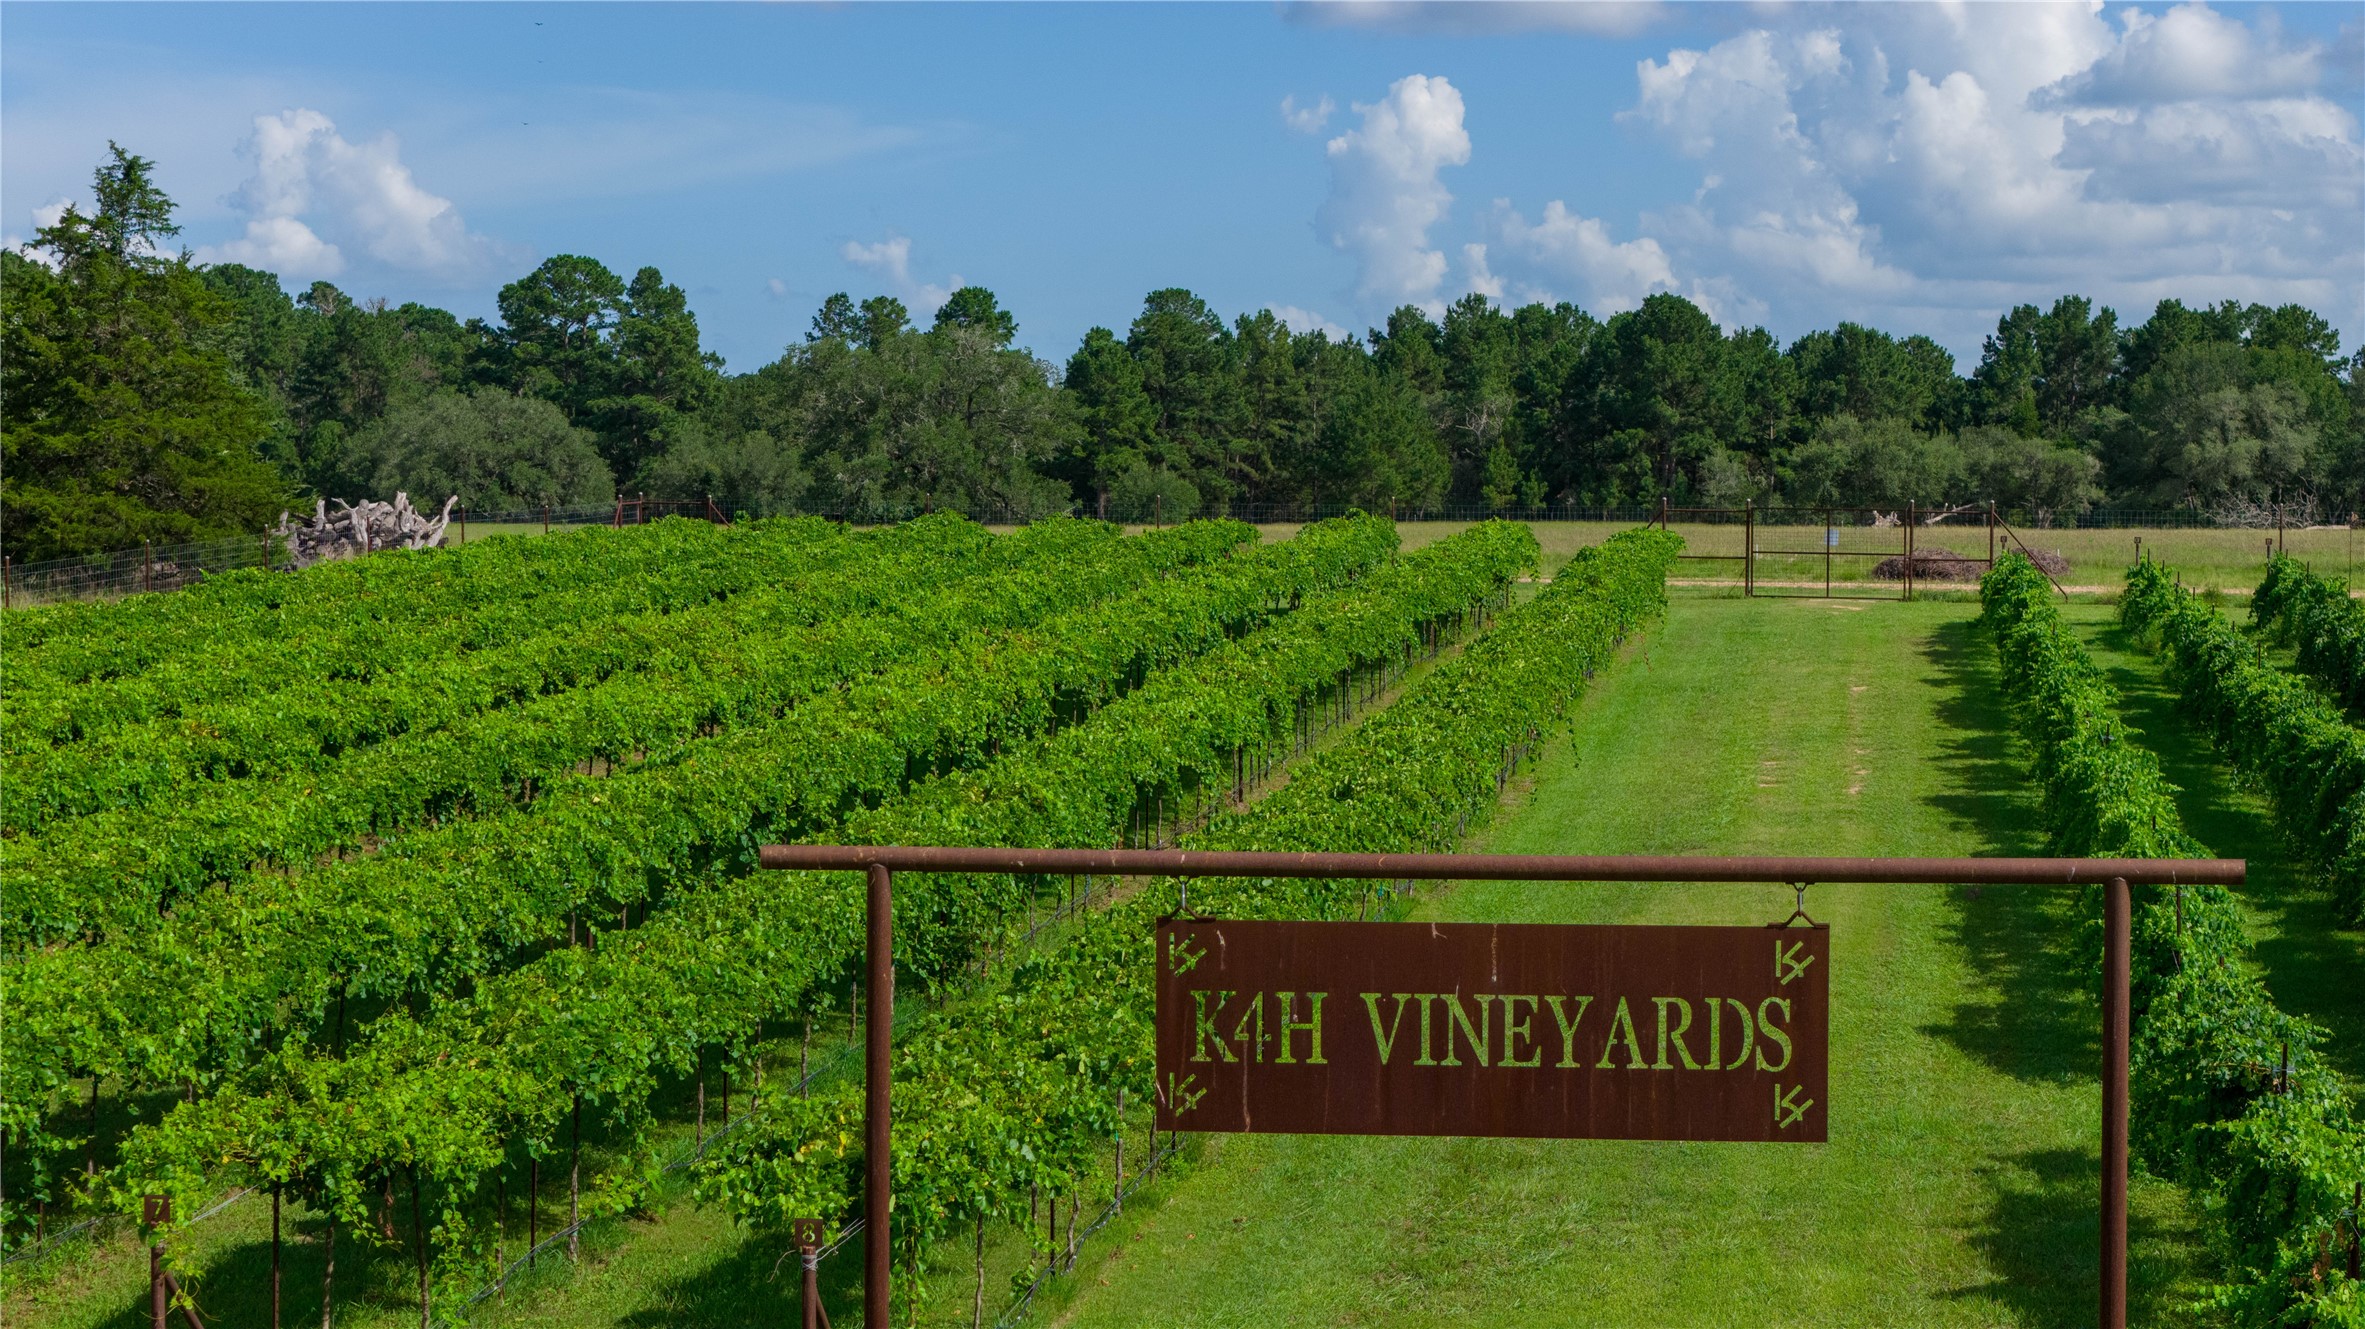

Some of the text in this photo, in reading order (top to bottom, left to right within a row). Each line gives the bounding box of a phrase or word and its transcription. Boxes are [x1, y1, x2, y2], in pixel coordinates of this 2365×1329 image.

[1189, 989, 1793, 1073] K4H VINEYARDS
[151, 1199, 164, 1218] 7
[802, 1222, 816, 1243] 8
